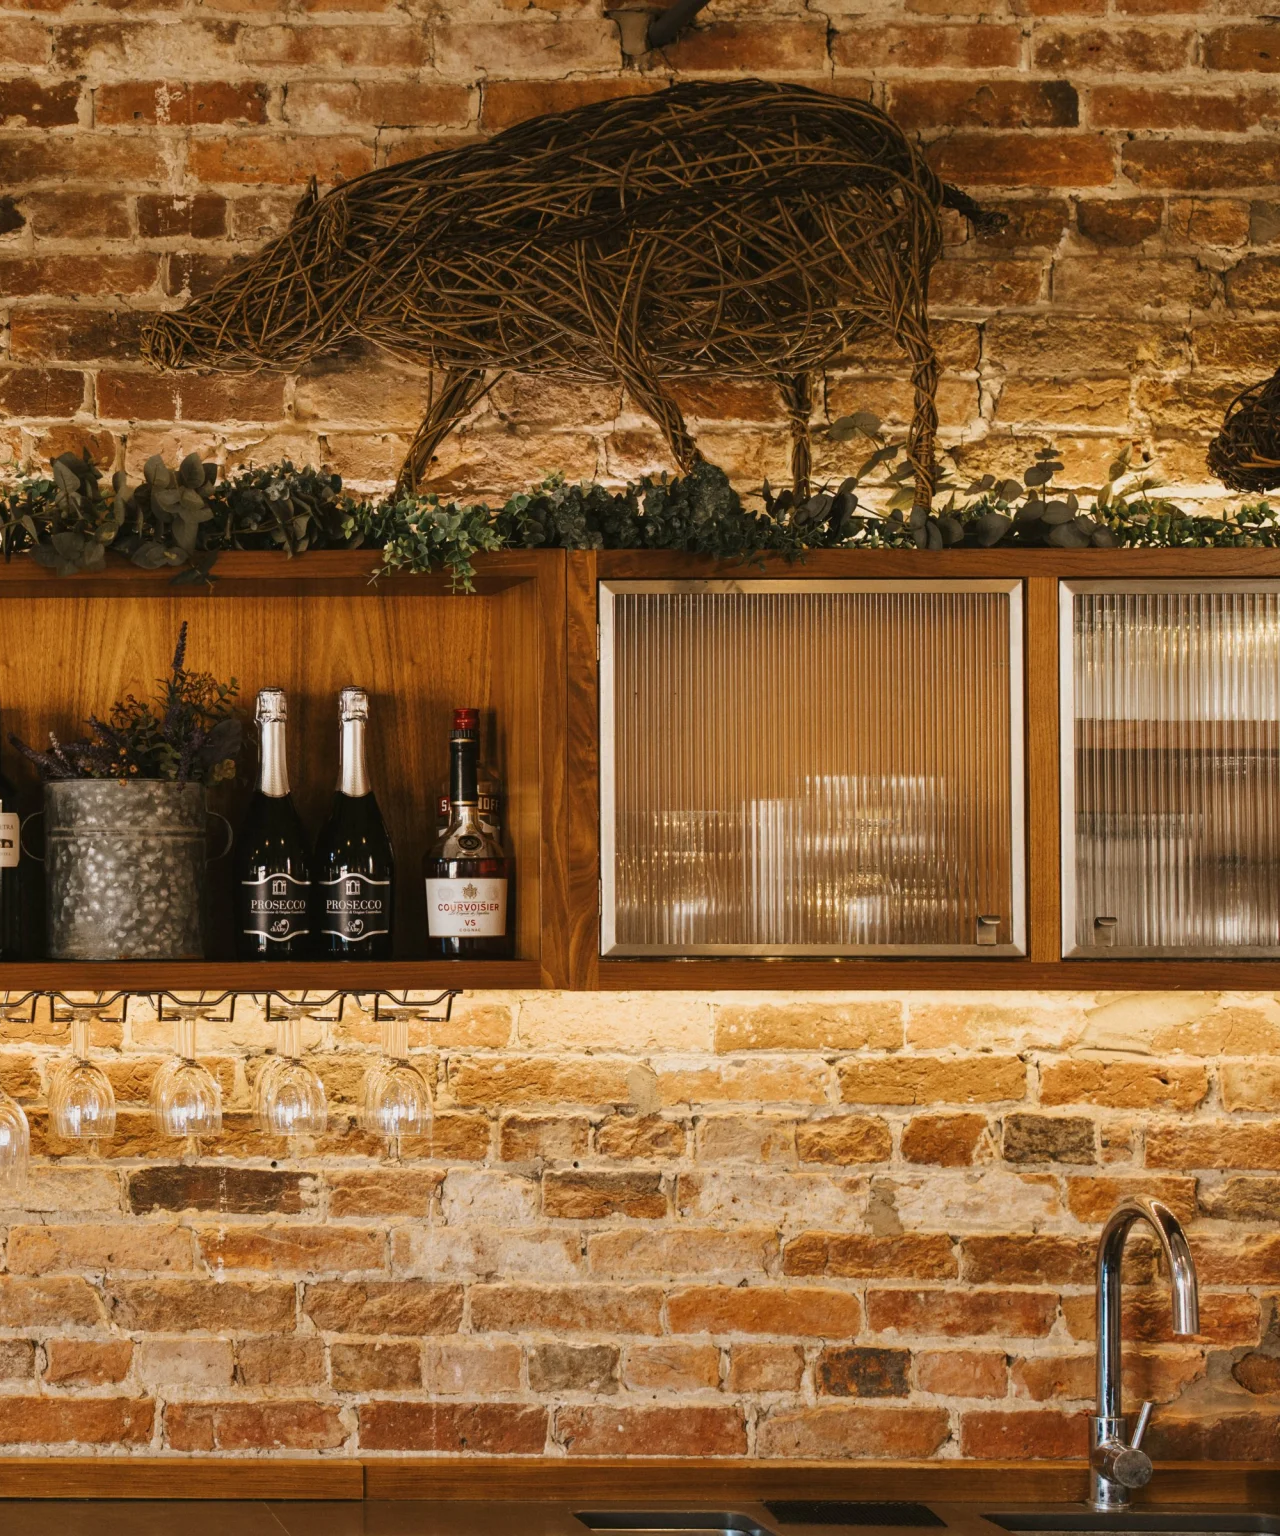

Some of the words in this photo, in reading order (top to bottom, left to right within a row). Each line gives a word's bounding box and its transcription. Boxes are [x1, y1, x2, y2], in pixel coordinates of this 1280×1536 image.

[251, 900, 306, 910] PROSECCO
[326, 900, 382, 910] PROSECCO
[438, 904, 499, 912] COURVOISIER
